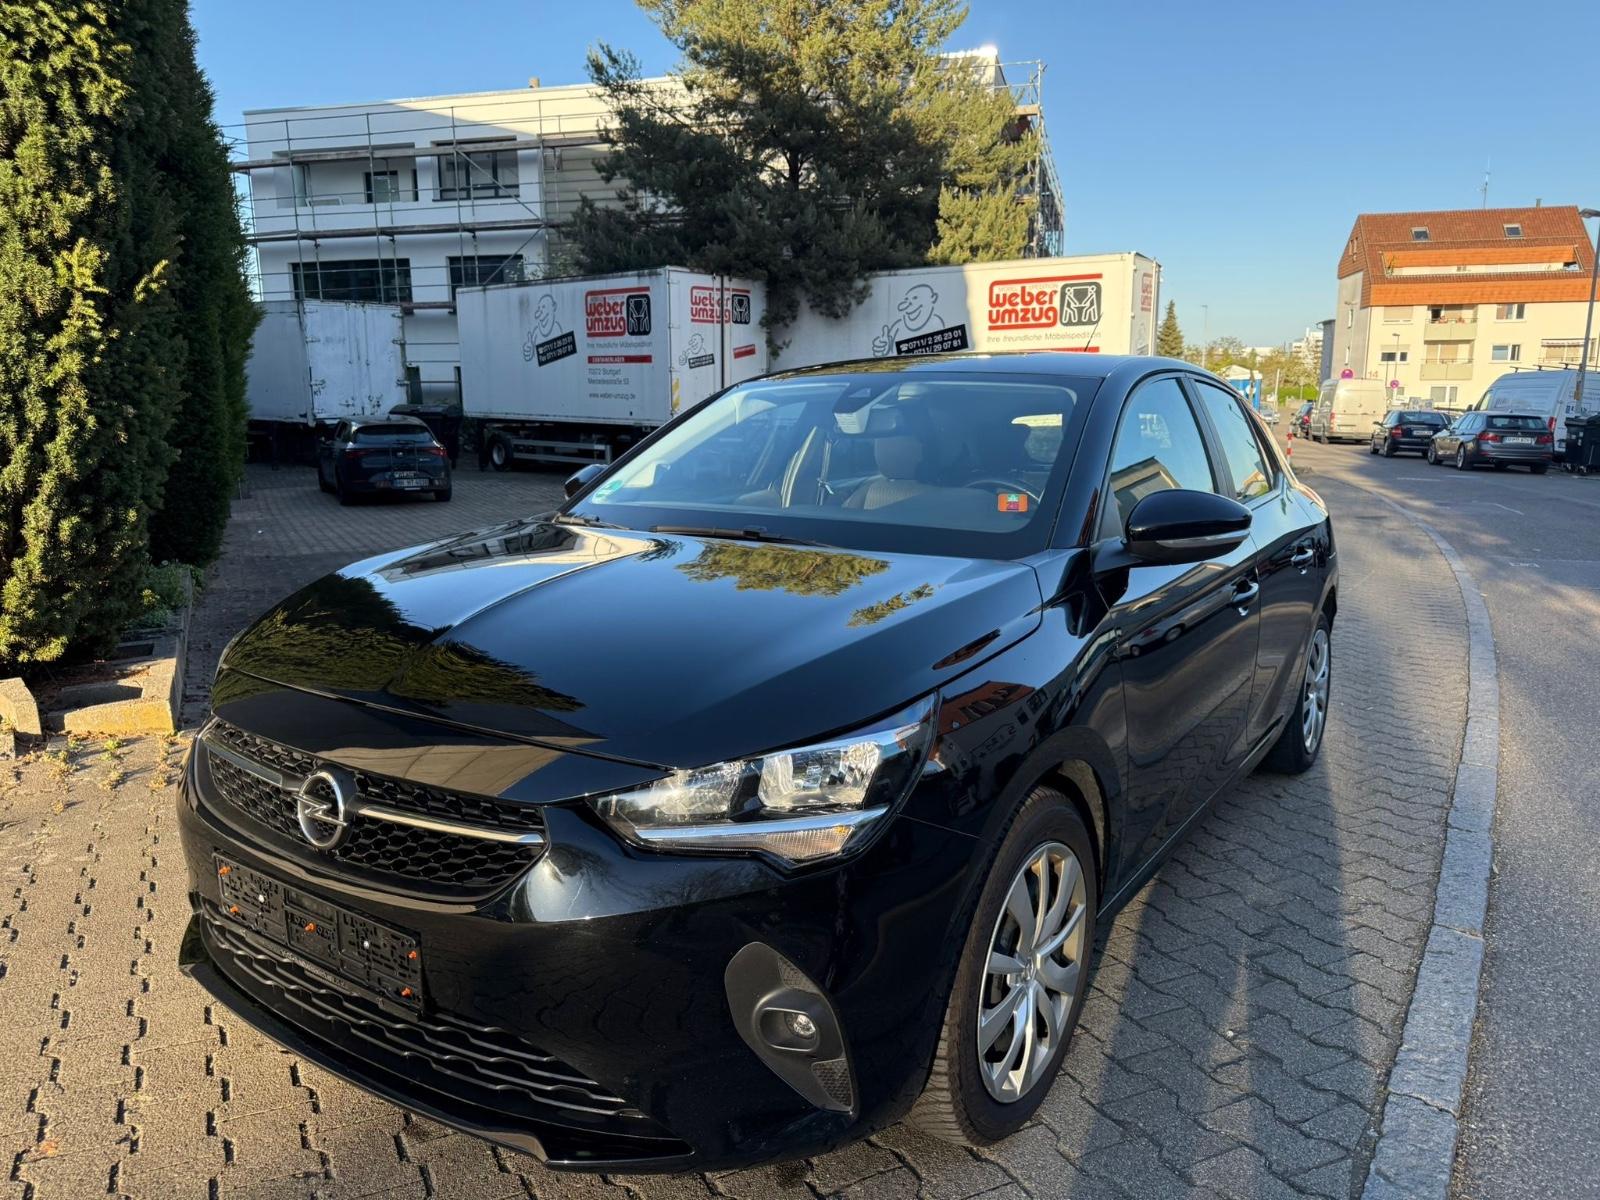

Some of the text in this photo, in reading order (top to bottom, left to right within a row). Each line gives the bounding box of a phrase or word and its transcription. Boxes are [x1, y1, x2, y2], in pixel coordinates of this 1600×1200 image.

[989, 286, 1058, 308] weber
[586, 298, 625, 317] weber
[988, 306, 1058, 326] umzug
[586, 316, 626, 333] umzug
[927, 336, 933, 345] 2
[953, 330, 962, 338] 01
